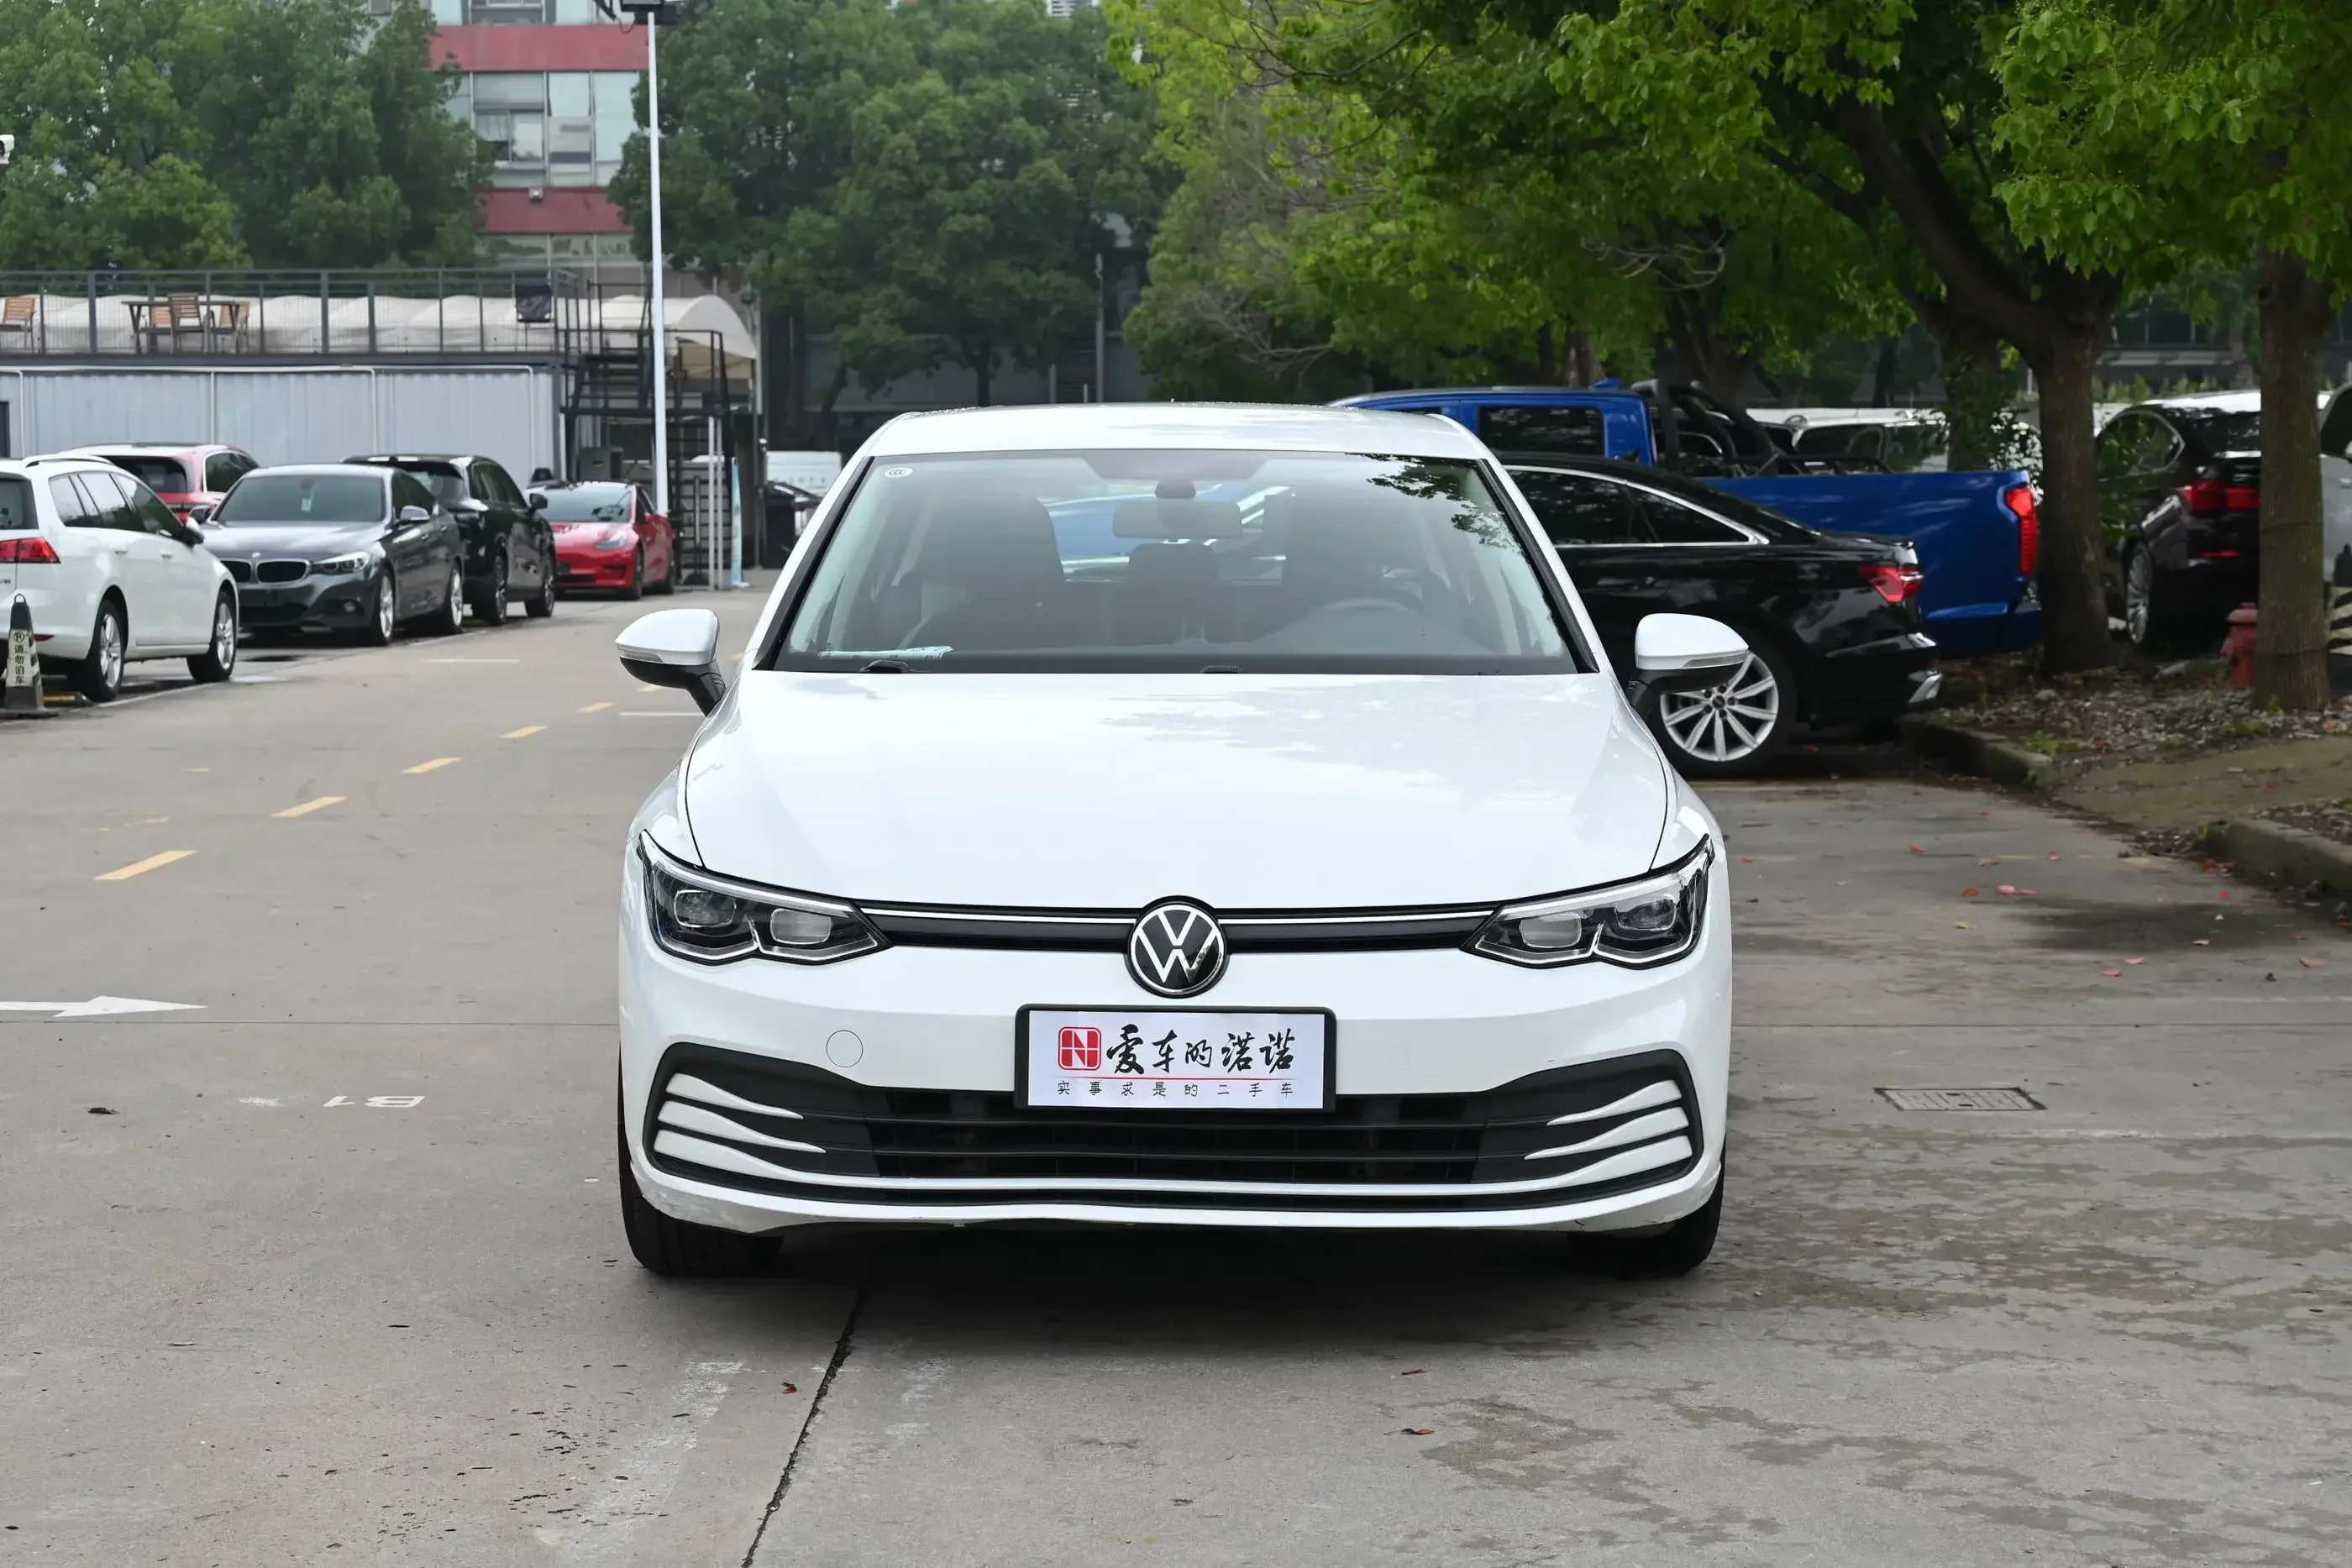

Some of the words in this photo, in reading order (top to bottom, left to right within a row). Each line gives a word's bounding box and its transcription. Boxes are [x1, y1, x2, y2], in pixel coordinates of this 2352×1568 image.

[15, 644, 24, 685] 请勿泊车
[1058, 1080, 1294, 1099] 实事求是的二手车
